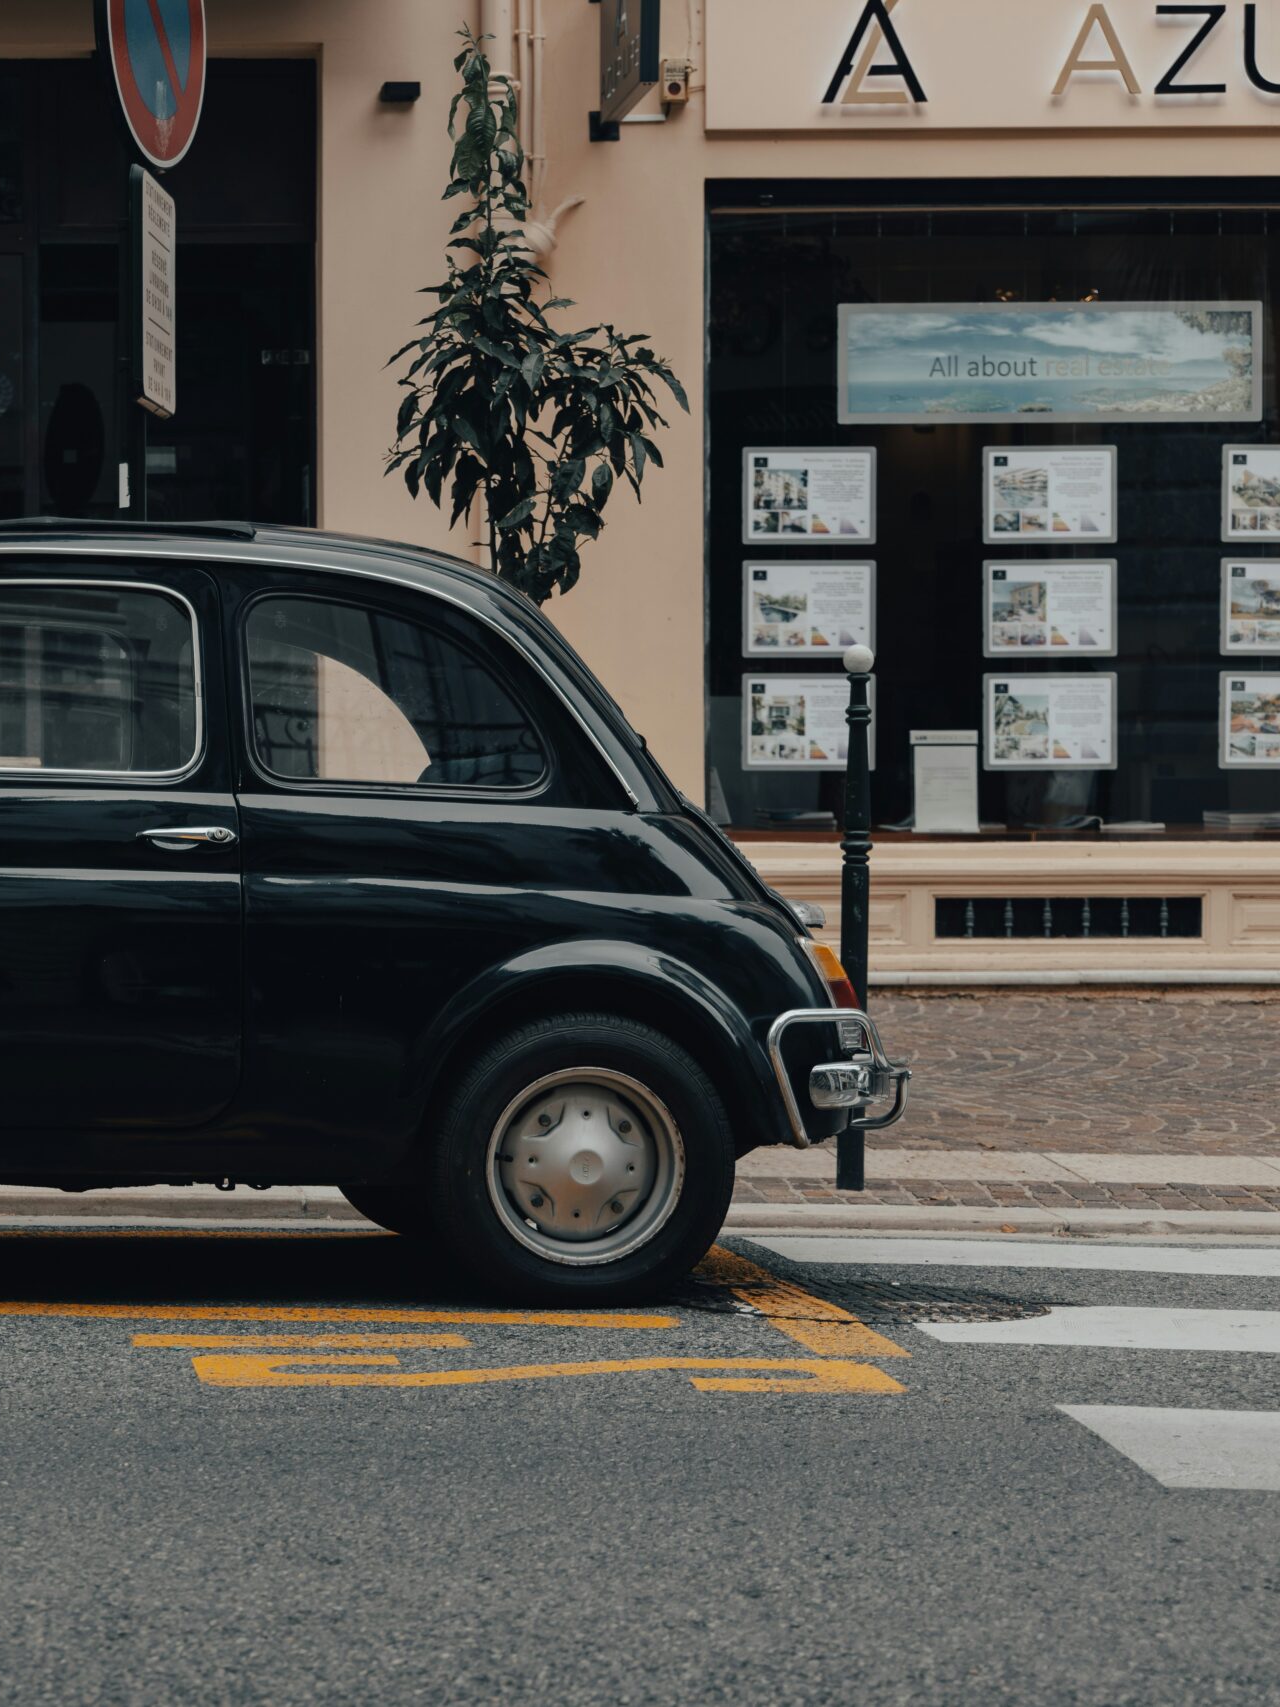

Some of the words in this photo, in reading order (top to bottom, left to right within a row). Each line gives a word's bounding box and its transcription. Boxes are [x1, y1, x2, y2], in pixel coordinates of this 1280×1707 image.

[929, 355, 959, 378] All
[967, 354, 1037, 377] about
[1045, 355, 1090, 377] real
[1097, 356, 1173, 377] estate
